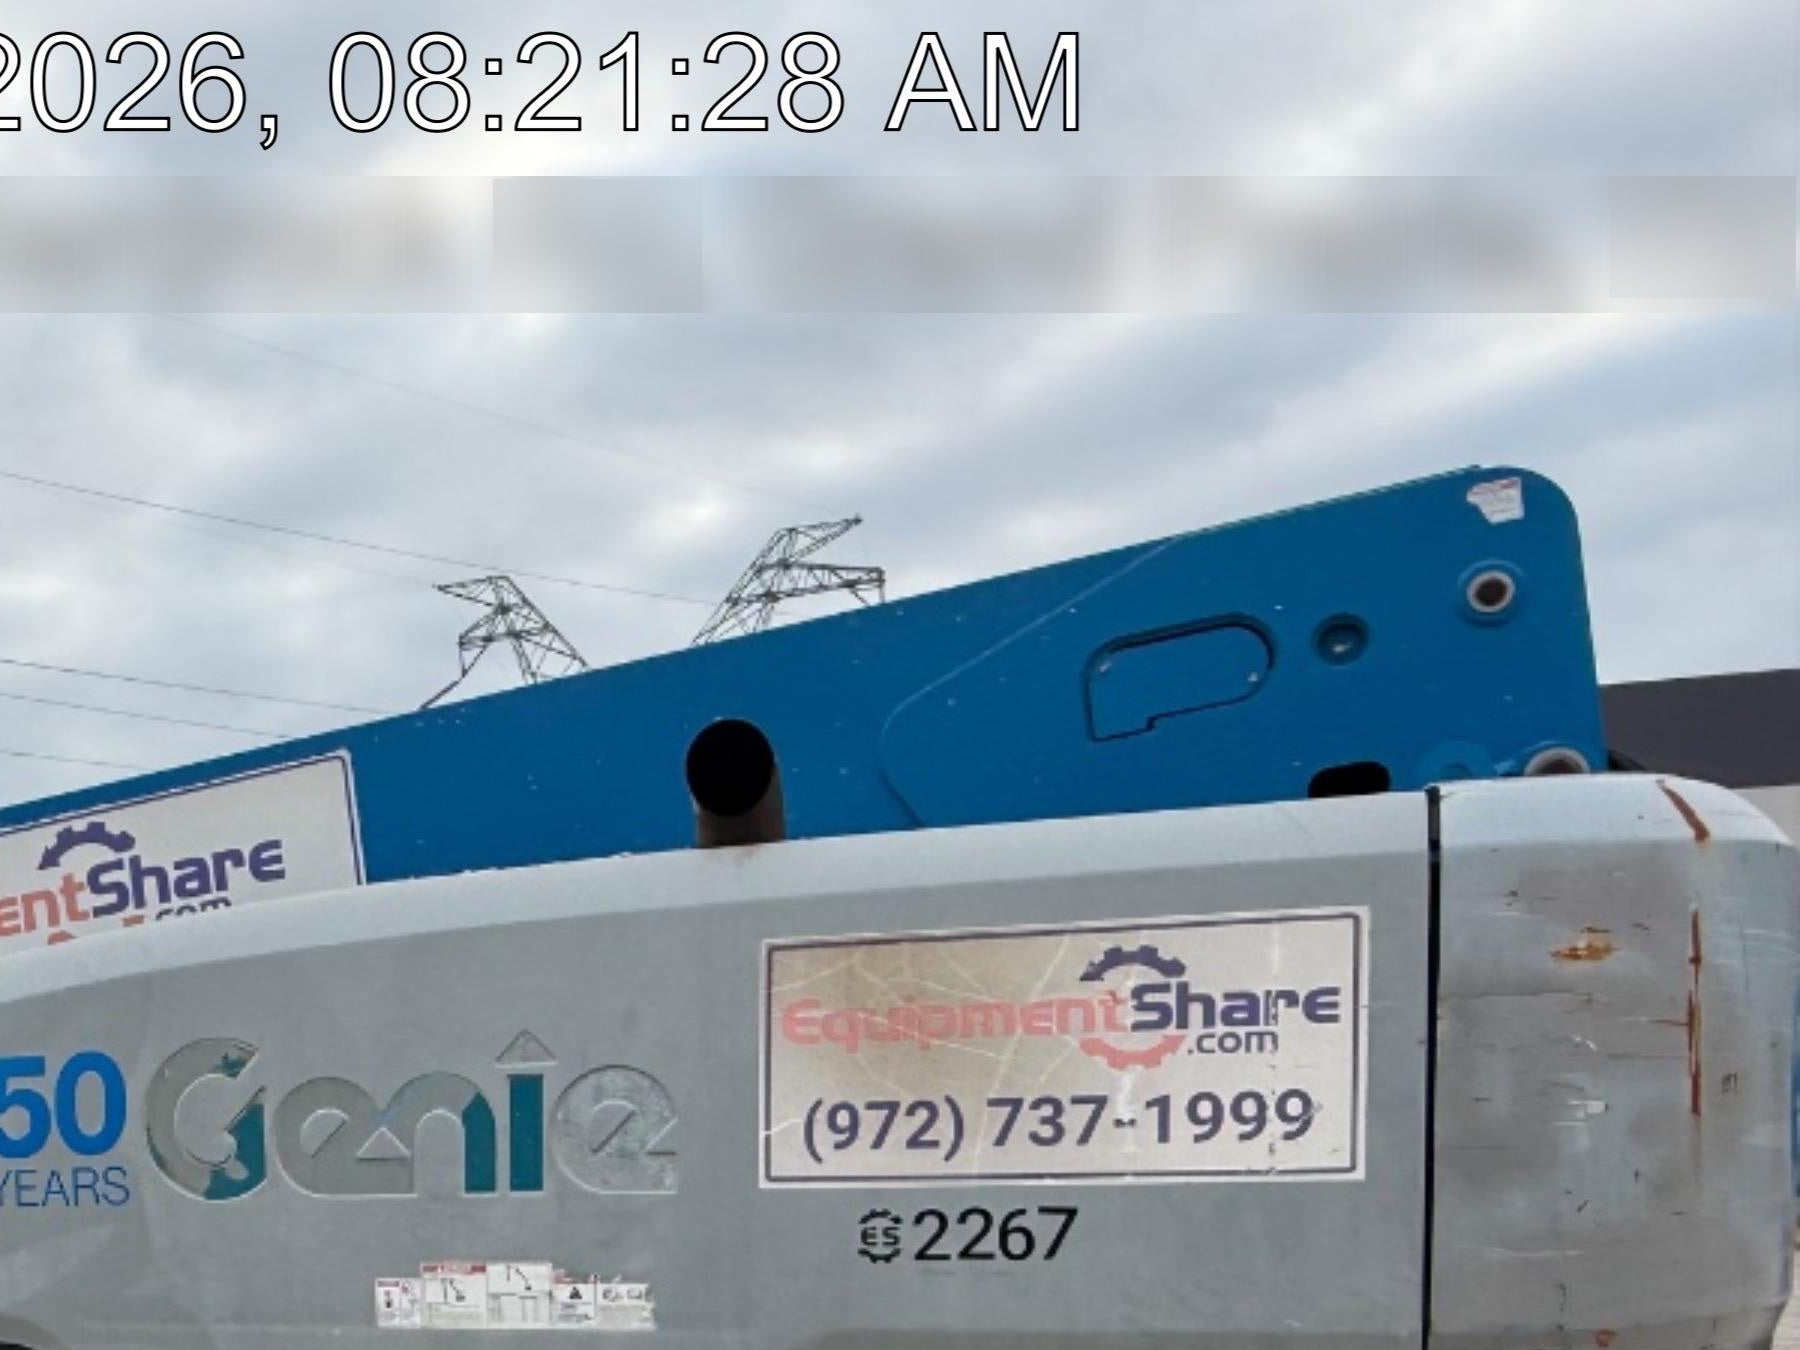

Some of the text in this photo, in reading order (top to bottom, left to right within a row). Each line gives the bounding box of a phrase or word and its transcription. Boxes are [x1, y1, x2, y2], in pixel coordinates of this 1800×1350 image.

[1187, 1031, 1280, 1055] .com
[145, 1028, 679, 1202] Genie
[802, 1087, 1317, 1163] (972) 737-1999
[912, 1205, 1079, 1261] 2267
